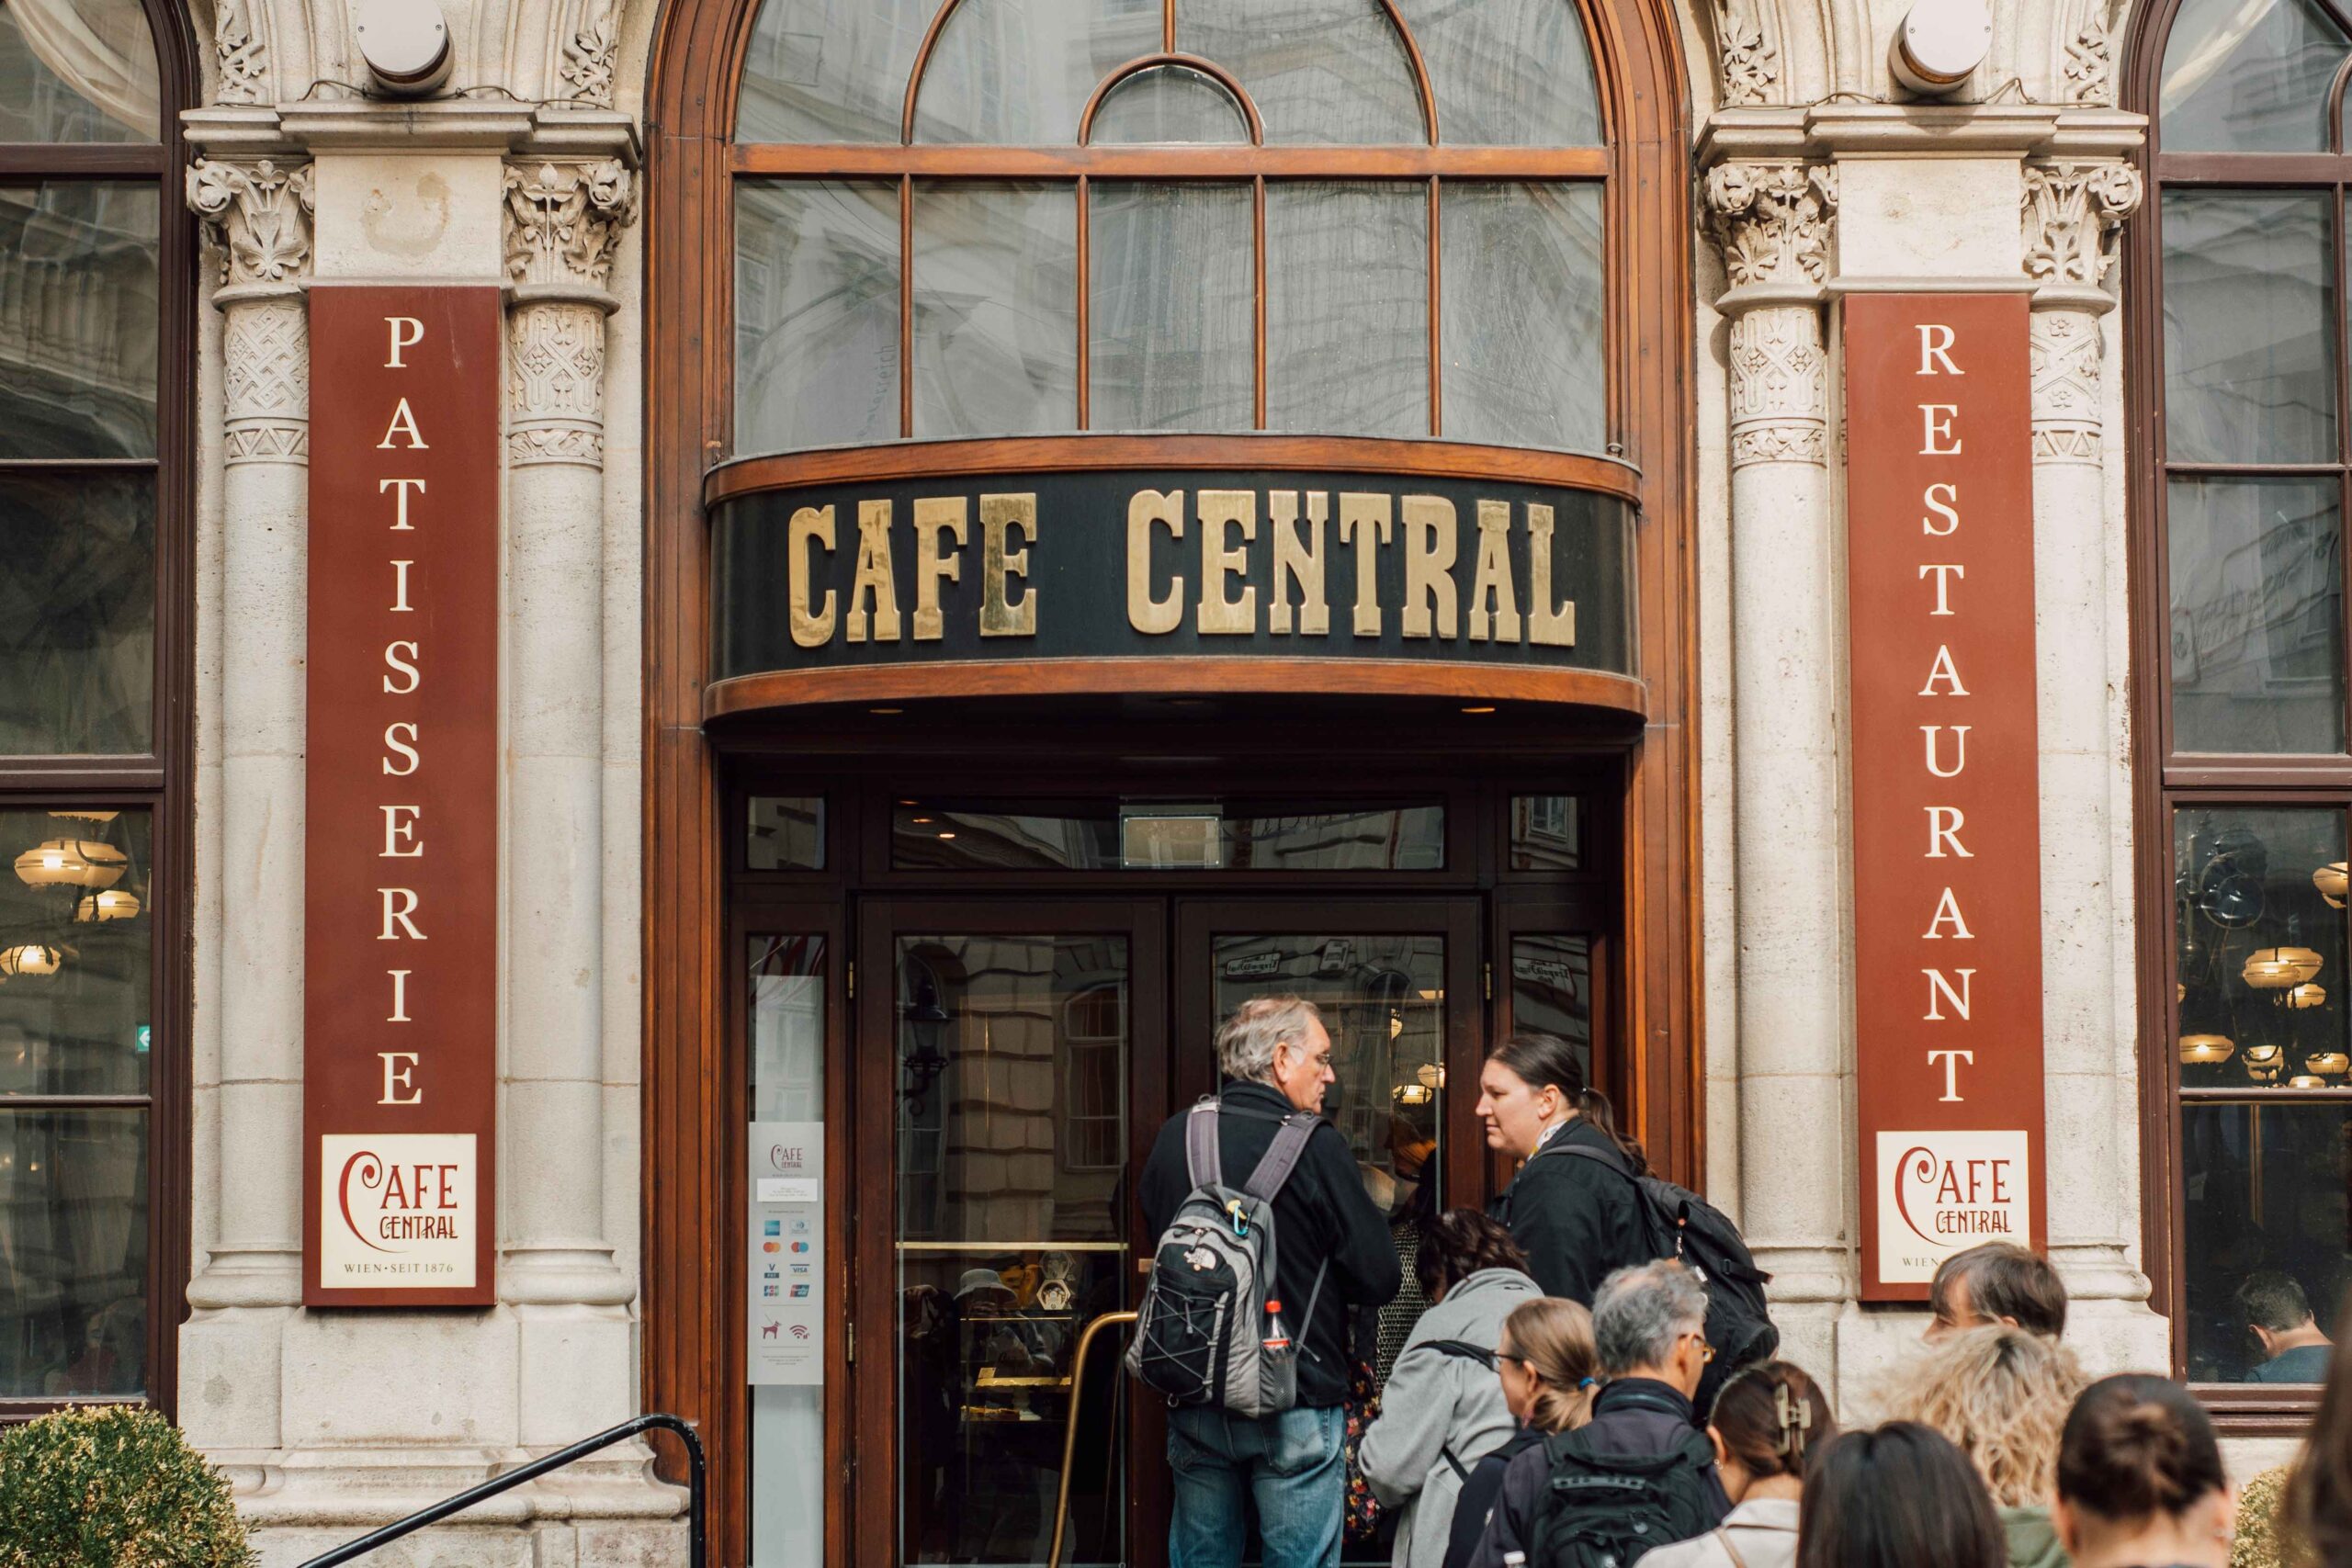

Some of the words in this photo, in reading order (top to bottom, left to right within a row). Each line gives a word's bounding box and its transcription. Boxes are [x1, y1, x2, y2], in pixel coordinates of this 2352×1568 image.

[787, 491, 1037, 648] CAFE
[1127, 490, 1576, 647] CENTRAL
[376, 316, 430, 1105] PATISSERIE
[1914, 323, 1977, 1102] RESTAURANT
[338, 1150, 458, 1254] CAFE
[771, 1144, 804, 1172] CAFE
[1894, 1145, 2012, 1247] CAFE
[379, 1215, 459, 1240] CENTRAL
[424, 1262, 454, 1273] 1876
[1935, 1210, 2013, 1234] CENTRAL
